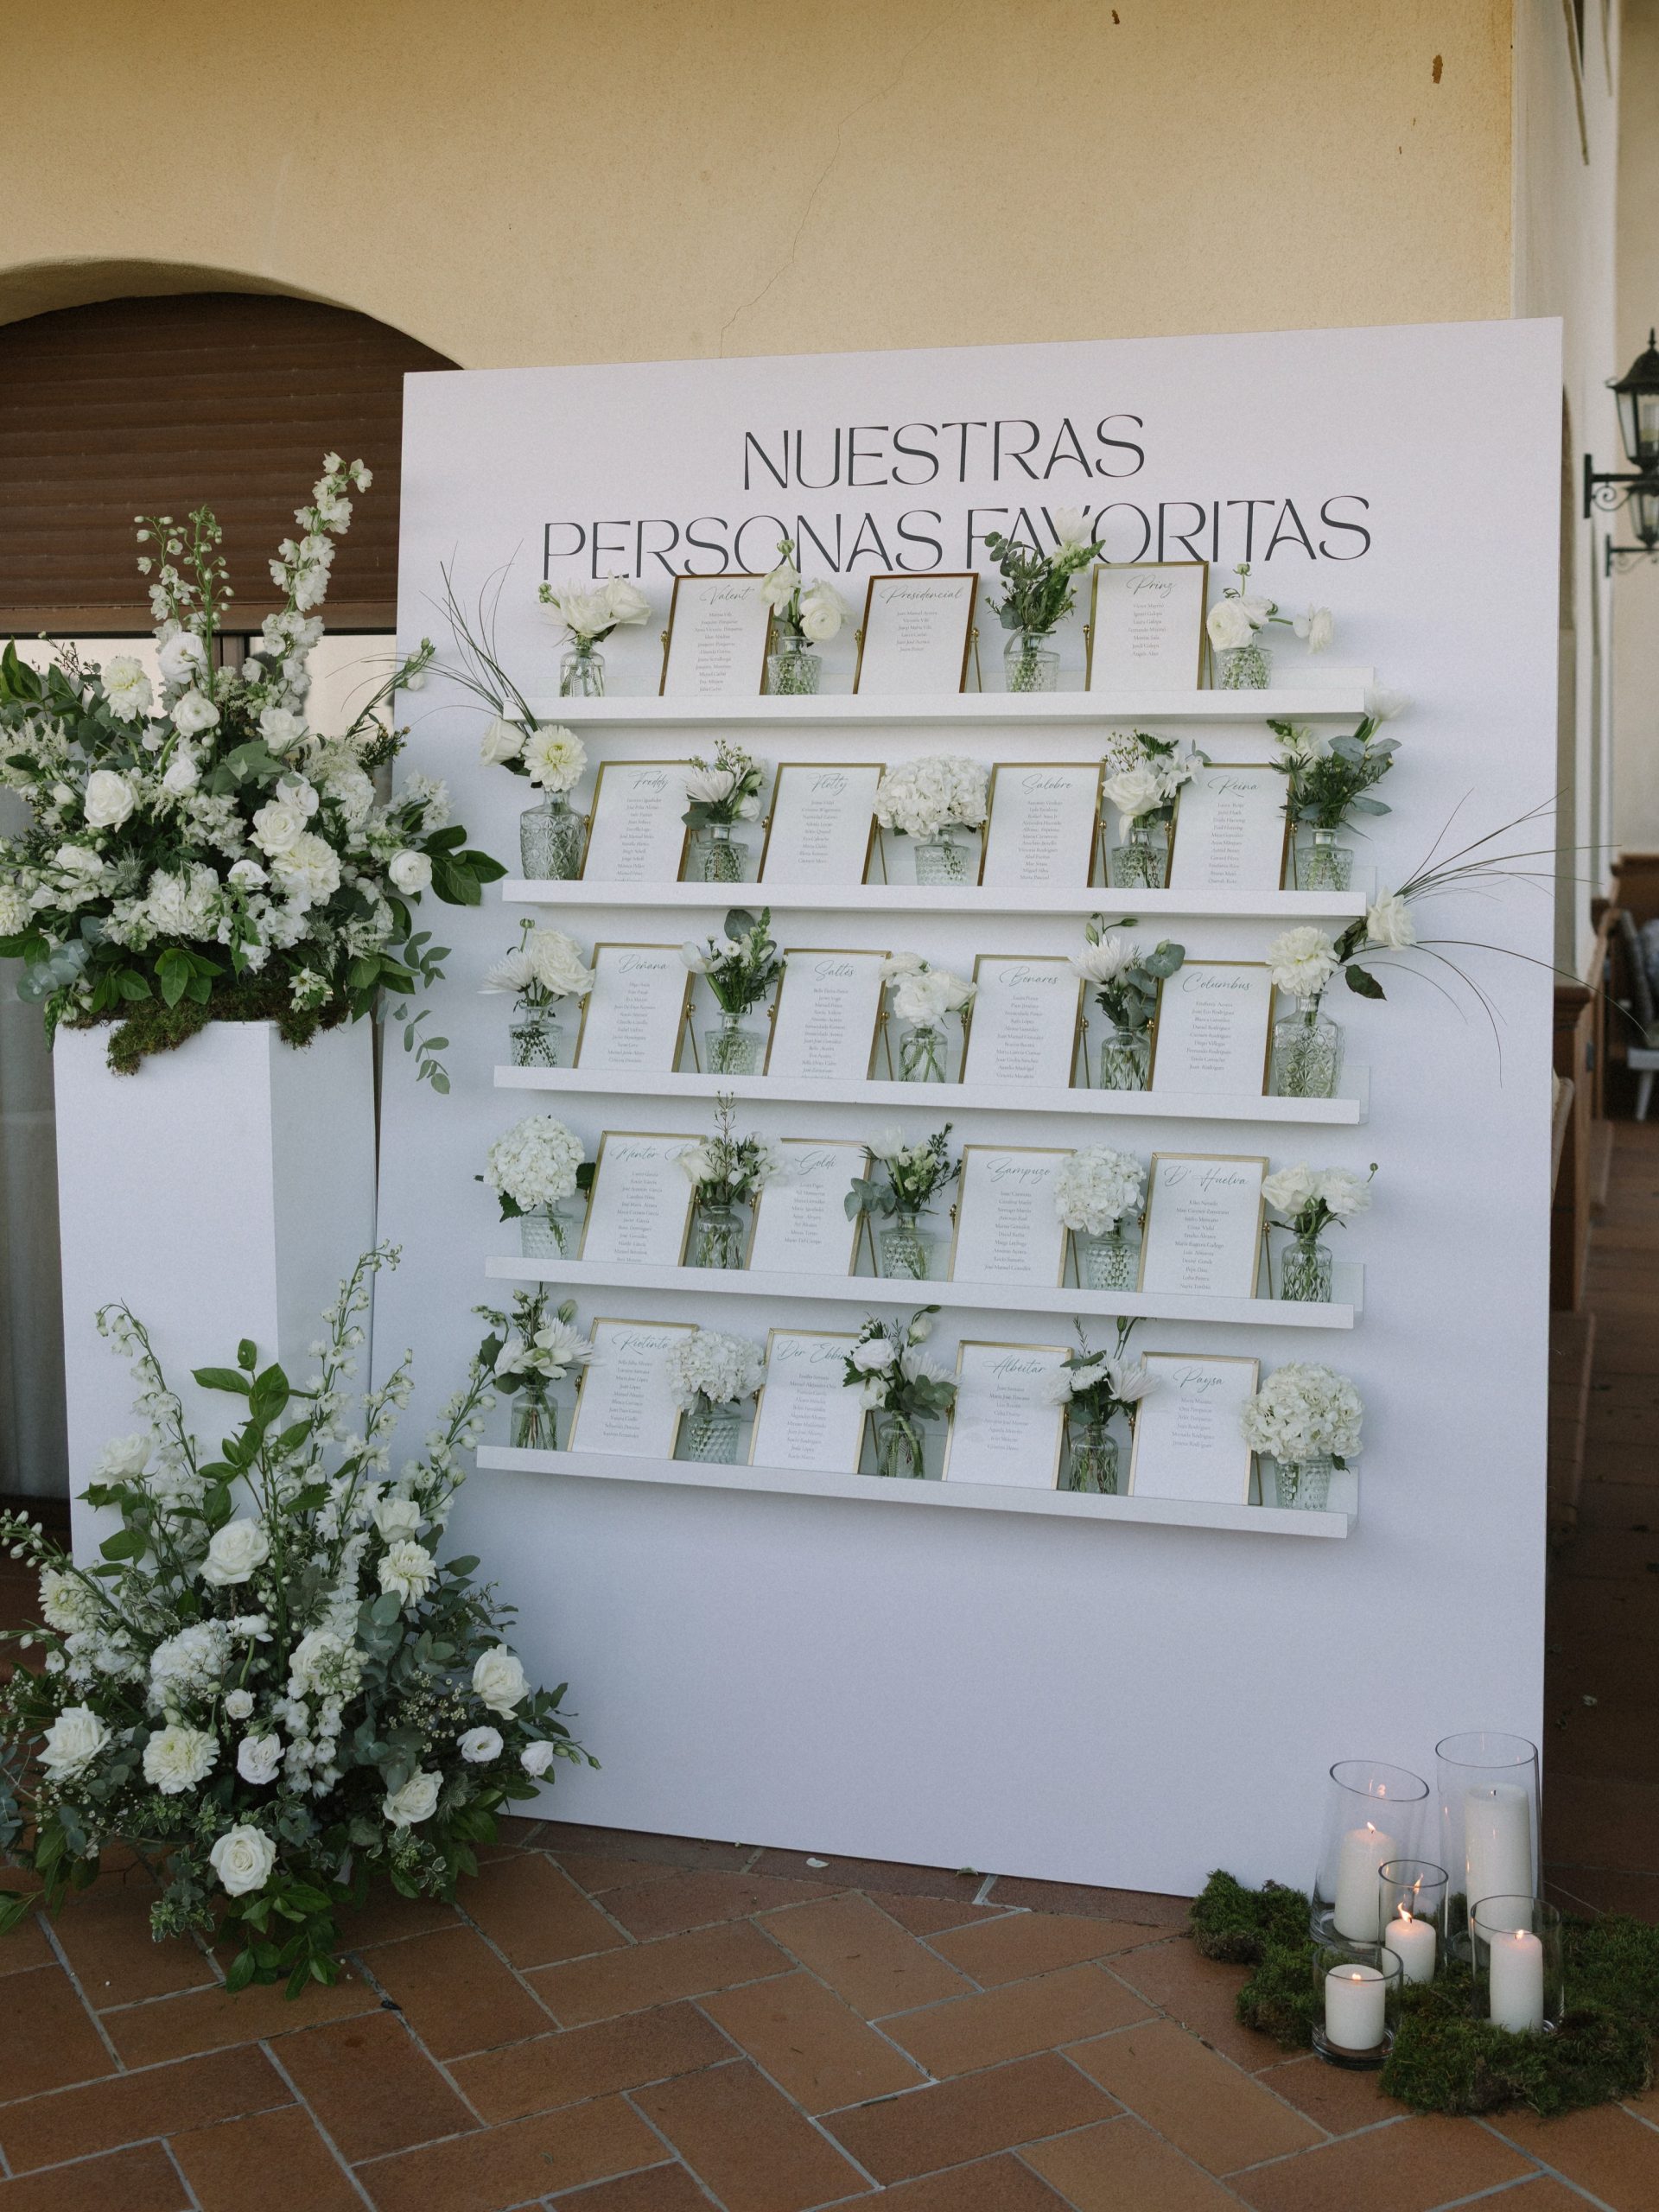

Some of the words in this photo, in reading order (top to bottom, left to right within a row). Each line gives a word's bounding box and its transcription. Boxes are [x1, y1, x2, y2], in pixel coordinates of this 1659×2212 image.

[743, 414, 1145, 491] NUESTRAS
[543, 509, 944, 580] PERSONAS
[879, 584, 964, 605] Presidencial
[628, 770, 670, 794] Freddy
[1022, 773, 1072, 795] Salobre
[1208, 775, 1258, 798] Reina
[1183, 972, 1252, 993] Columbus
[987, 1157, 1051, 1185] Zampuzo
[1192, 1167, 1248, 1192] Huelva
